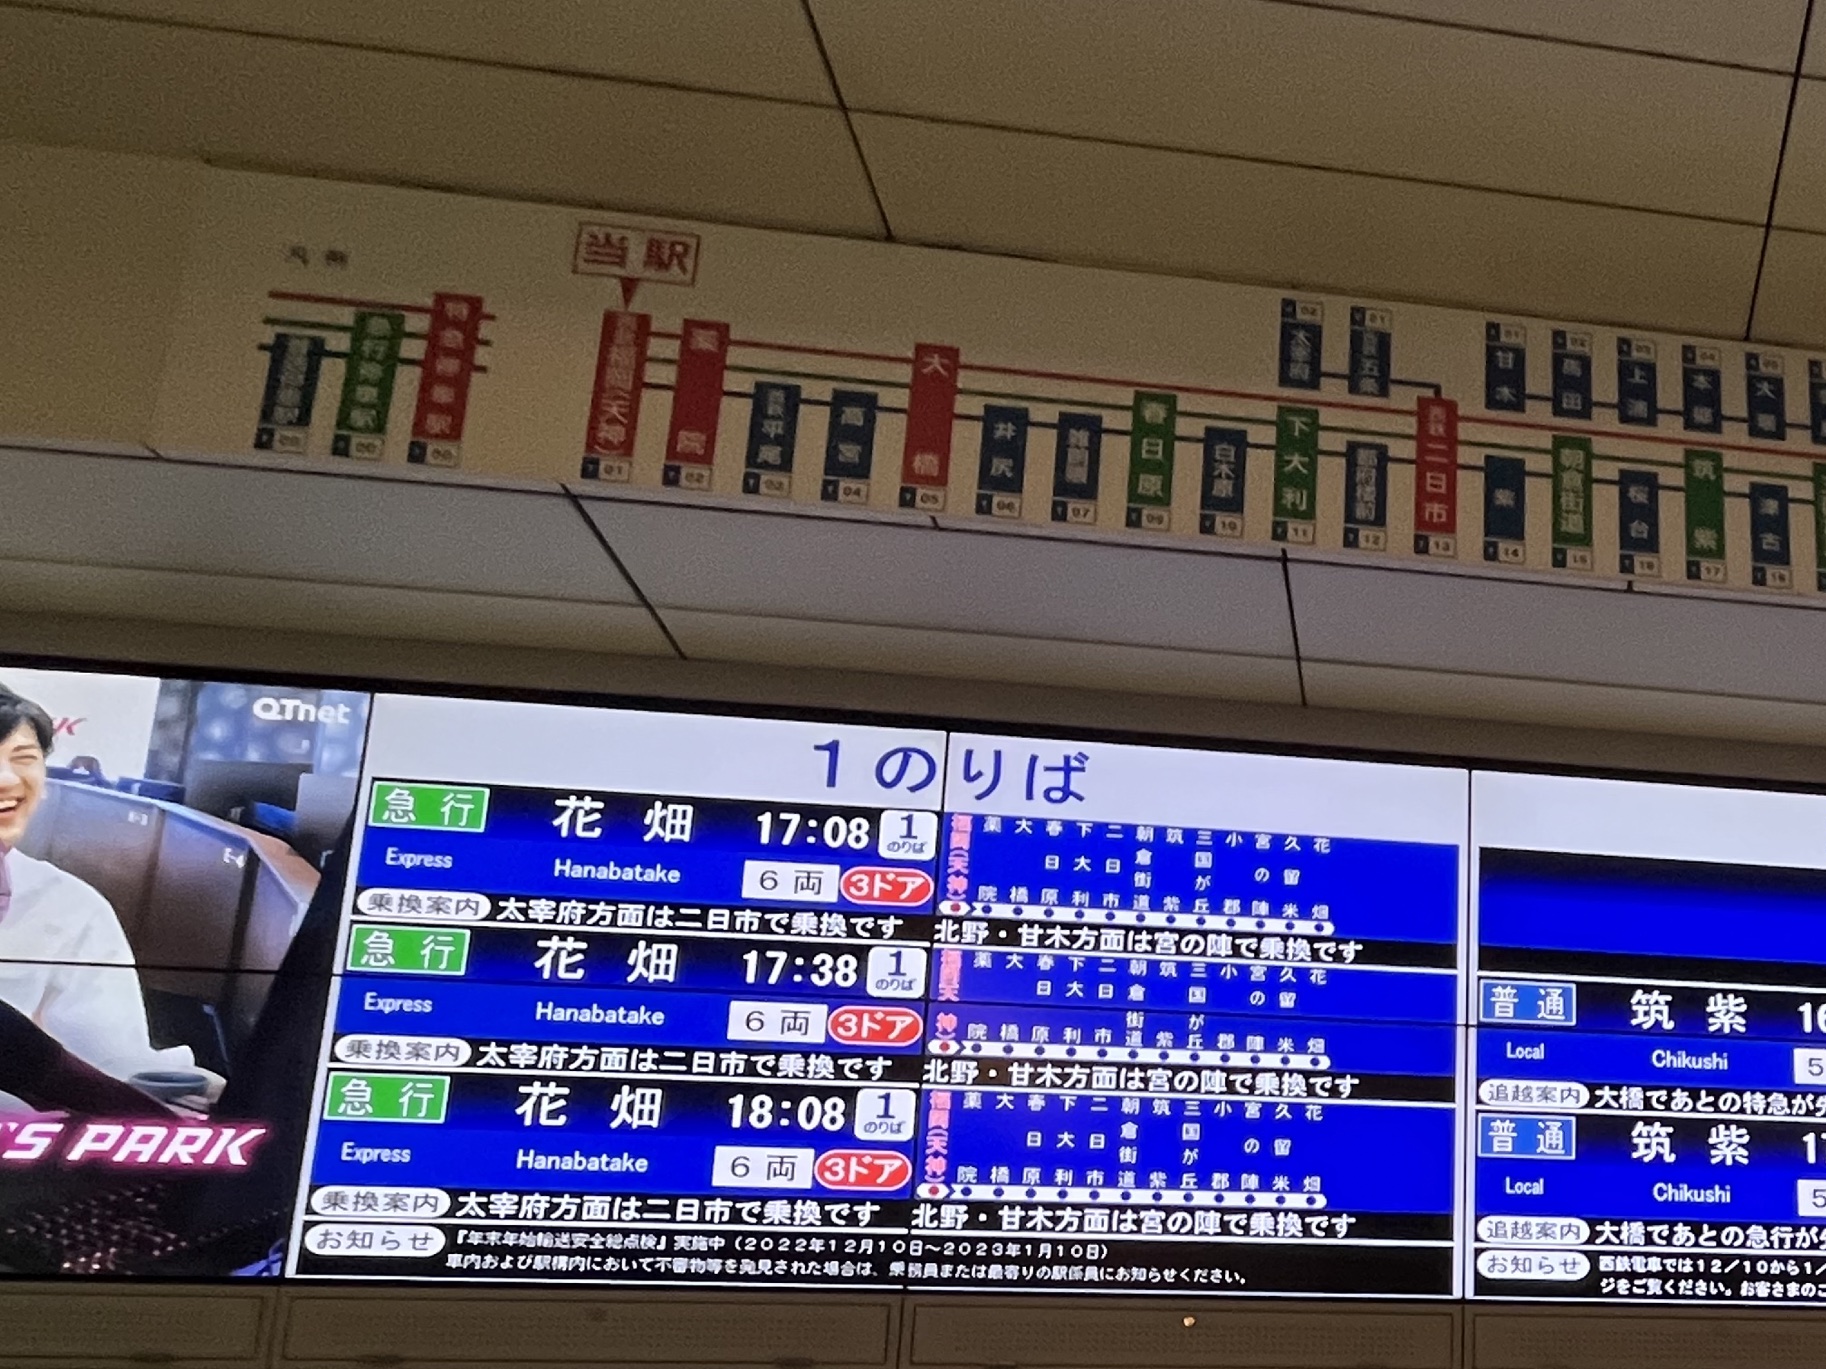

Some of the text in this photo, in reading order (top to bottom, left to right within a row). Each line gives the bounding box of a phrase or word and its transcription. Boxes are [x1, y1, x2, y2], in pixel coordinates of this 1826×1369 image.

[582, 232, 690, 275] 当駅
[1283, 412, 1312, 512] 下大利
[252, 697, 352, 727] QTnet
[382, 788, 476, 828] 急行
[552, 795, 693, 844] 花畑
[755, 811, 871, 850] 17:08
[898, 815, 917, 841] 1
[385, 848, 453, 871] Express
[554, 858, 682, 884] Hanabatake
[848, 872, 927, 900] 3ドア
[367, 892, 481, 919] 乗換案内
[496, 897, 905, 941] 太宰府方面は二日市で乗換です
[361, 930, 456, 970] 急行
[933, 921, 1364, 964] 北野・甘木方面は宮の陣で乗換です
[533, 935, 679, 983] 花畑
[742, 950, 859, 987] 17:38
[886, 952, 907, 977] 1
[363, 993, 435, 1016] Express
[535, 1001, 665, 1027] Hanabatake
[1490, 987, 1567, 1022] 普通
[1629, 989, 1748, 1035] 筑紫
[834, 1012, 918, 1041] 3ドア
[344, 1037, 463, 1064] 乗換案内
[475, 1042, 894, 1082] 太宰府方面は二日市で乗換です
[1506, 1042, 1545, 1061] Local
[1651, 1050, 1729, 1071] Chikushi
[922, 1058, 1361, 1099] 北野・甘木方面は宮の陣で乗換です
[336, 1080, 437, 1119] 急行
[514, 1083, 665, 1130] 花畑
[875, 1093, 896, 1120] 1
[1488, 1082, 1581, 1106] 追越案内
[728, 1093, 847, 1133] 18:08
[66, 1124, 267, 1167] PARK
[1488, 1121, 1567, 1154] 普通
[1630, 1123, 1751, 1167] 筑紫
[341, 1142, 412, 1167] Express
[516, 1149, 650, 1175] Hanabatake
[822, 1156, 906, 1187] 3ドア
[1505, 1176, 1544, 1196] Local
[320, 1189, 442, 1216] 乗換案内
[1652, 1183, 1731, 1205] Chikushi
[454, 1190, 882, 1229] 太宰府方面は二日市で乗換です
[910, 1203, 1358, 1240] 北野・甘木方面は宮の陣で乗換です
[319, 1226, 436, 1252] お知らせ
[1486, 1219, 1582, 1243] 追越案内
[1486, 1252, 1582, 1277] お知らせ
